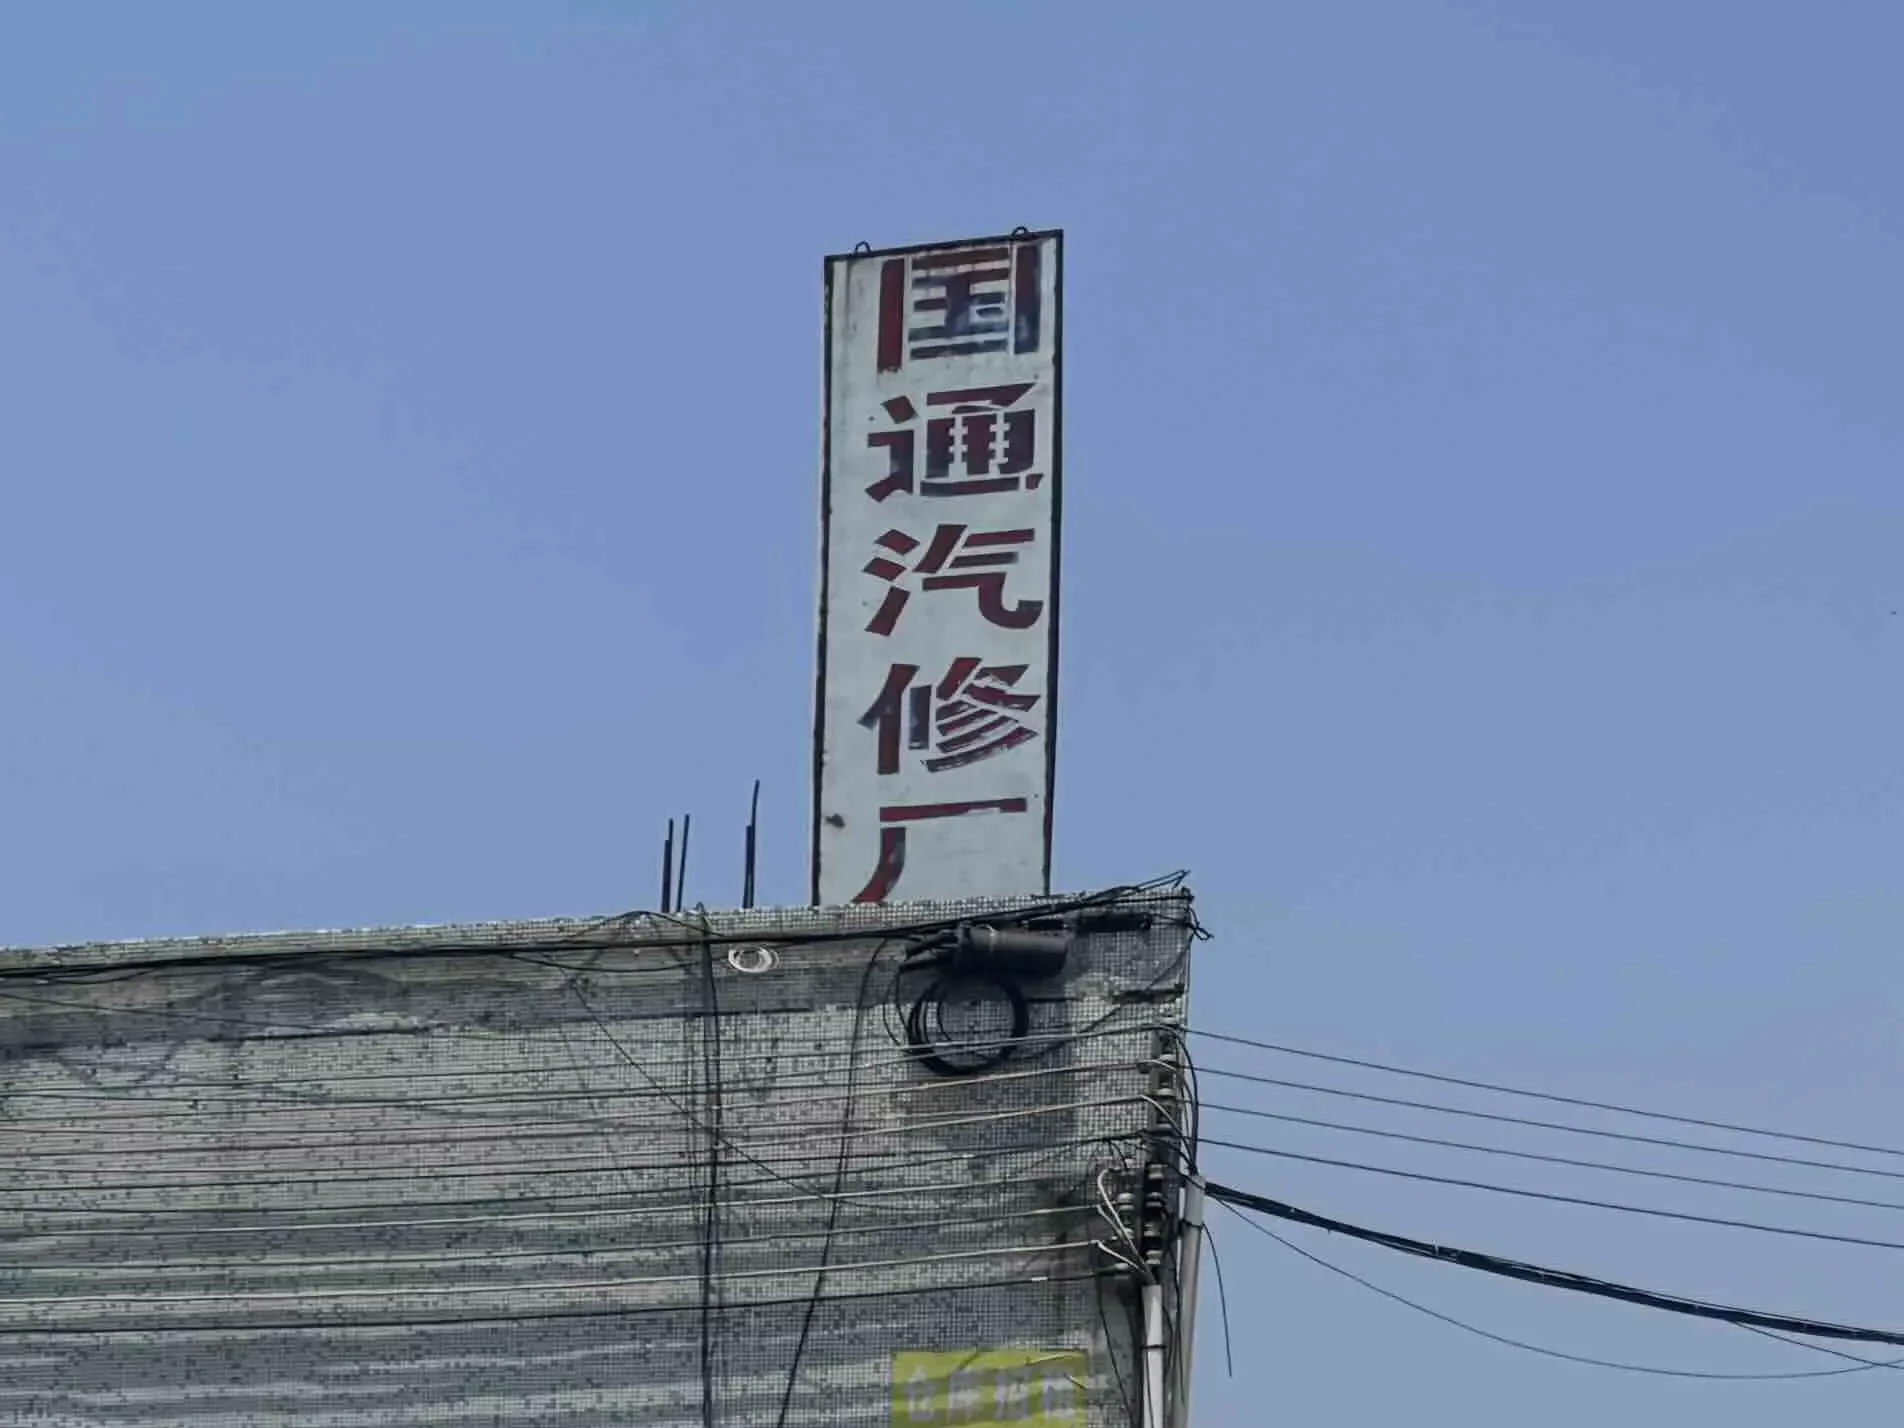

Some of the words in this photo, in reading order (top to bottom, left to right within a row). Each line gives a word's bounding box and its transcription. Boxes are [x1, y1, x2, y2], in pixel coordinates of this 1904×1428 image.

[852, 246, 1044, 903] 国通汽修厂
